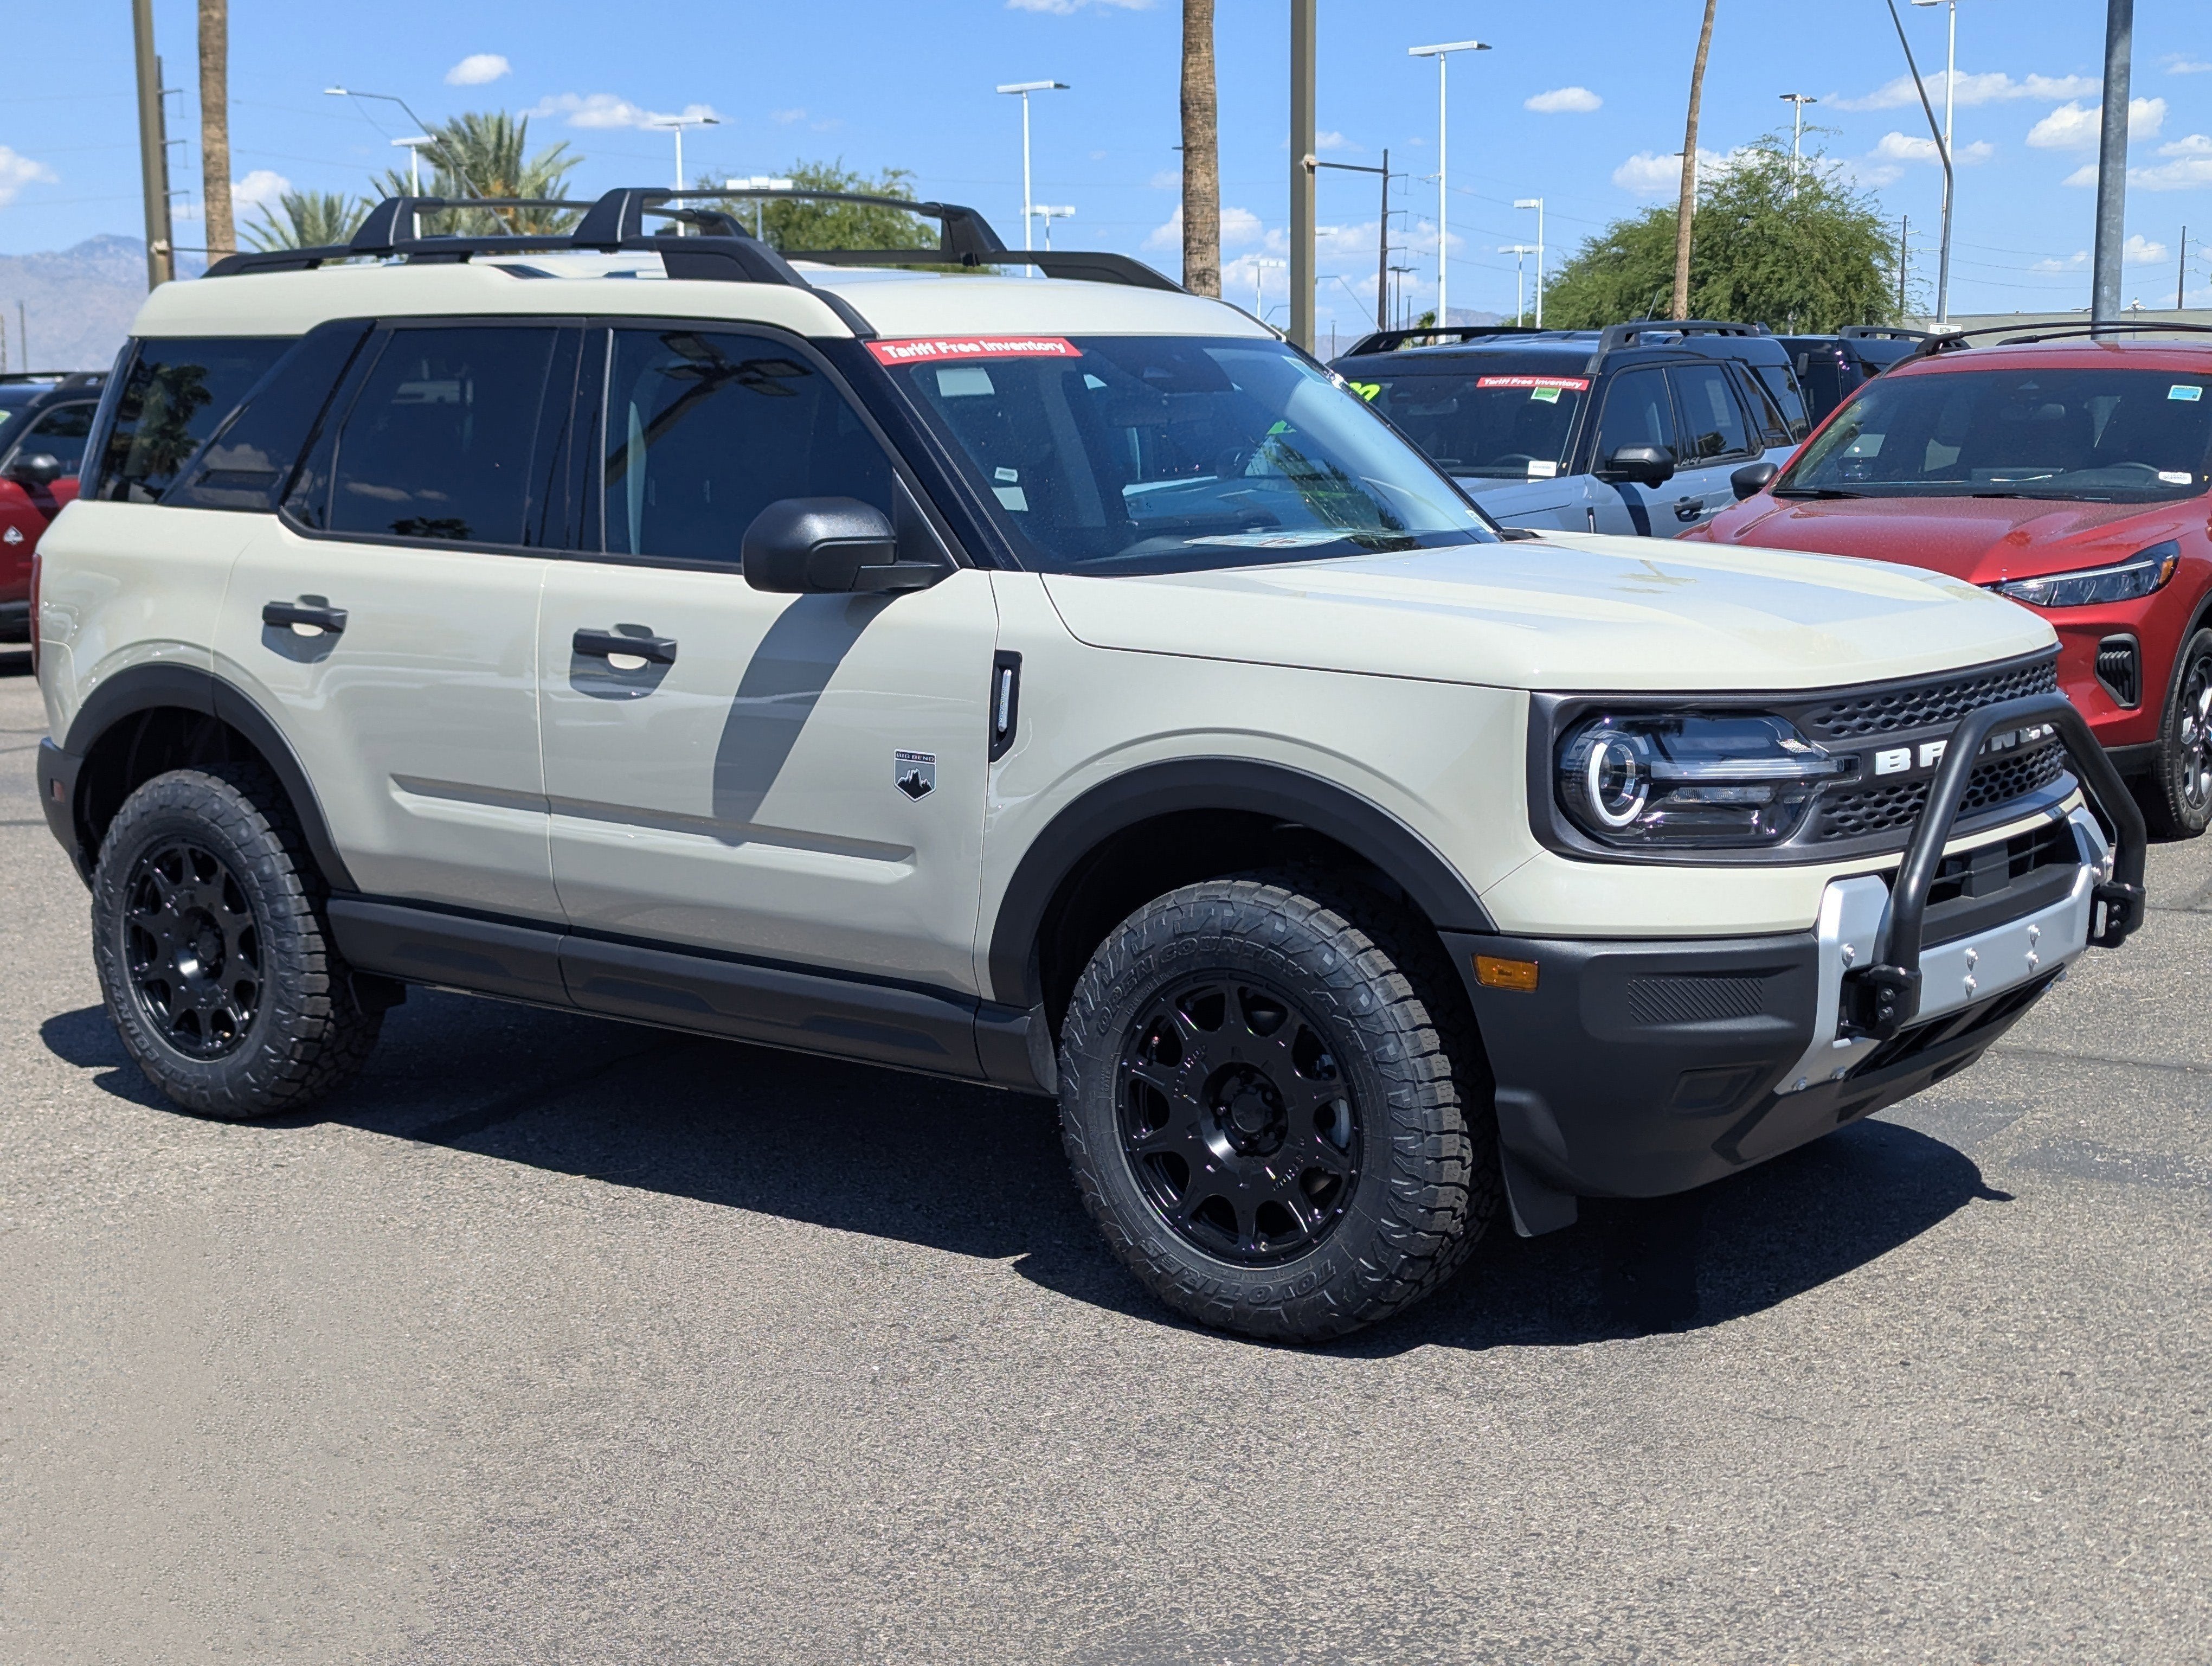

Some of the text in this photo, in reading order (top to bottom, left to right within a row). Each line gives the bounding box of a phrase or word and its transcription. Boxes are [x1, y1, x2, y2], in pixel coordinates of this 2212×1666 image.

[882, 340, 1066, 358] Tariff Free Inventory
[1535, 379, 1583, 388] Inventory
[1875, 723, 2054, 776] BRNC
[1139, 1237, 1336, 1303] TOYO TIRES
